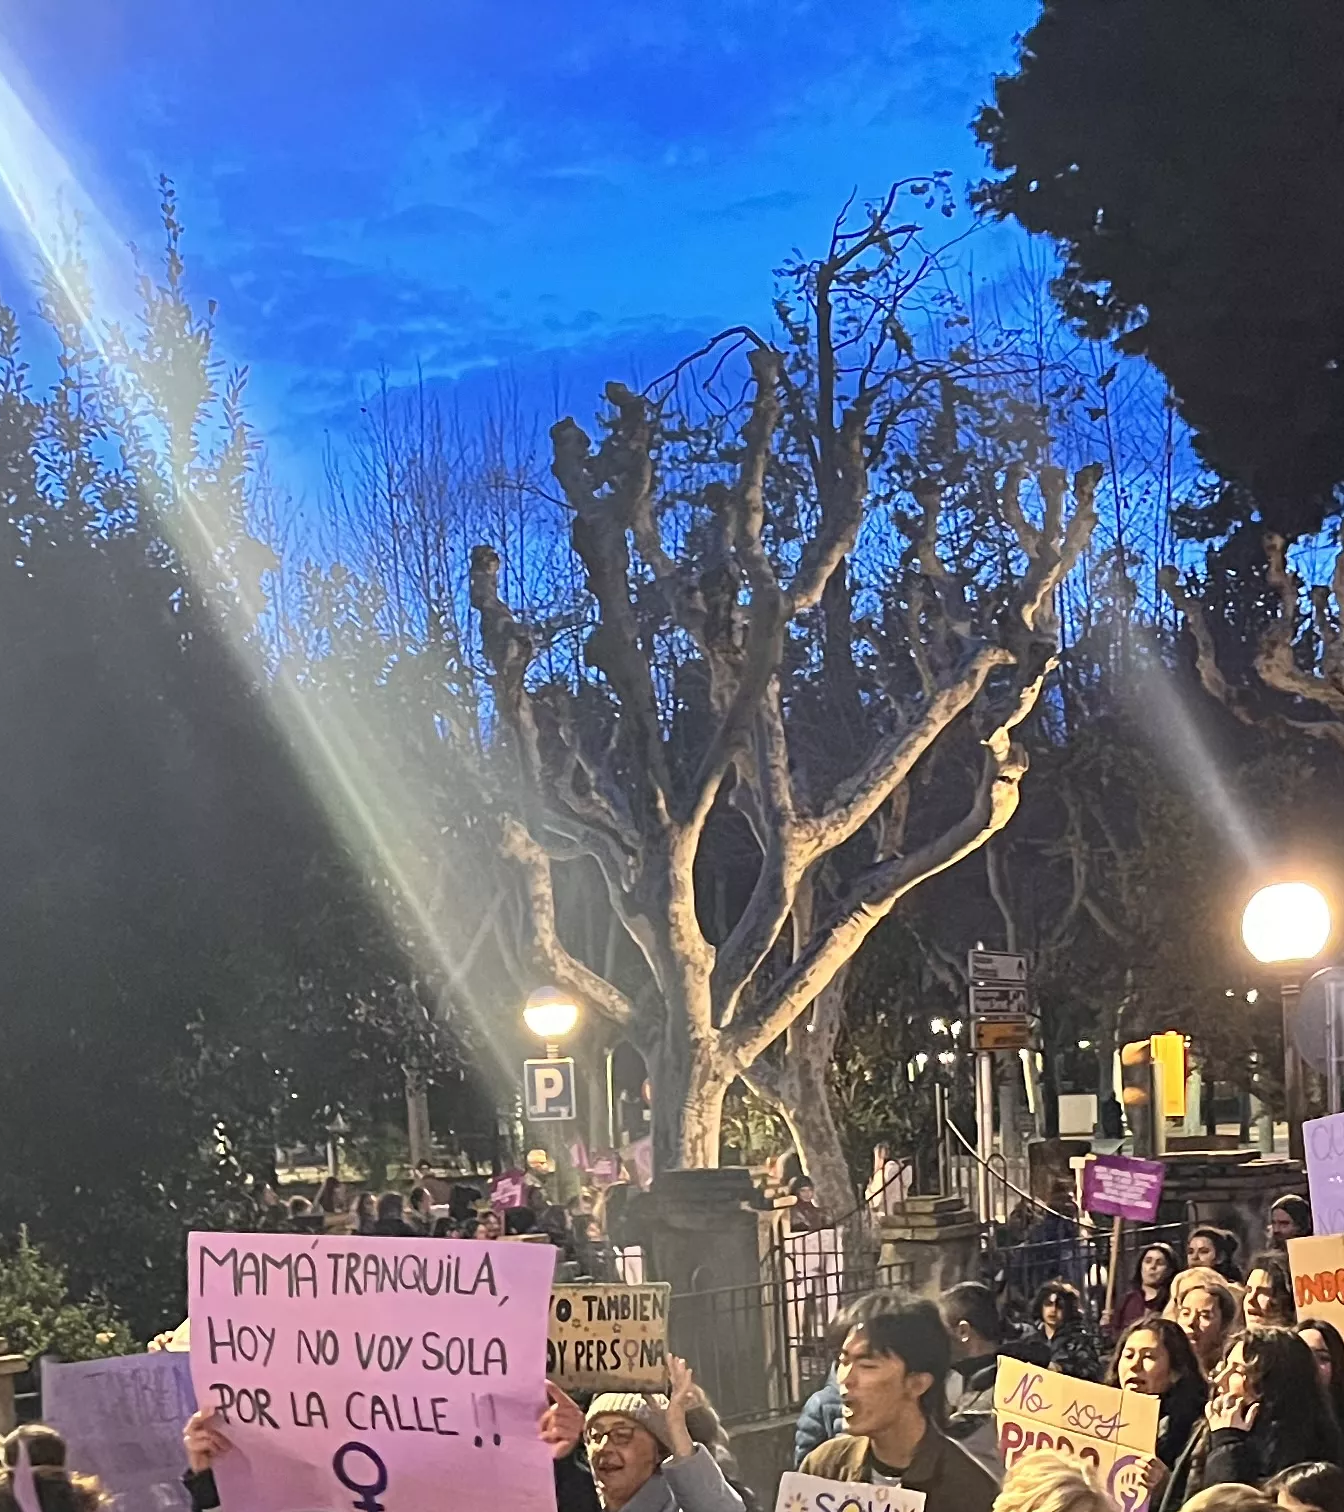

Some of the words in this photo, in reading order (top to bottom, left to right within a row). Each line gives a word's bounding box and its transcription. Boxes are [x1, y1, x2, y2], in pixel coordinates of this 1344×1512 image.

[535, 1068, 564, 1113] P
[199, 1239, 318, 1299] MAMÁ
[582, 1293, 666, 1322] TAMBIEN
[207, 1316, 276, 1368] HOY
[297, 1328, 340, 1367] NO
[355, 1331, 415, 1373] VOY
[422, 1331, 508, 1376] SOLA
[209, 1383, 281, 1431] POR
[290, 1391, 330, 1429] LA
[345, 1391, 460, 1437] CALLE
[1004, 1373, 1053, 1413] No
[1062, 1400, 1130, 1439] soy
